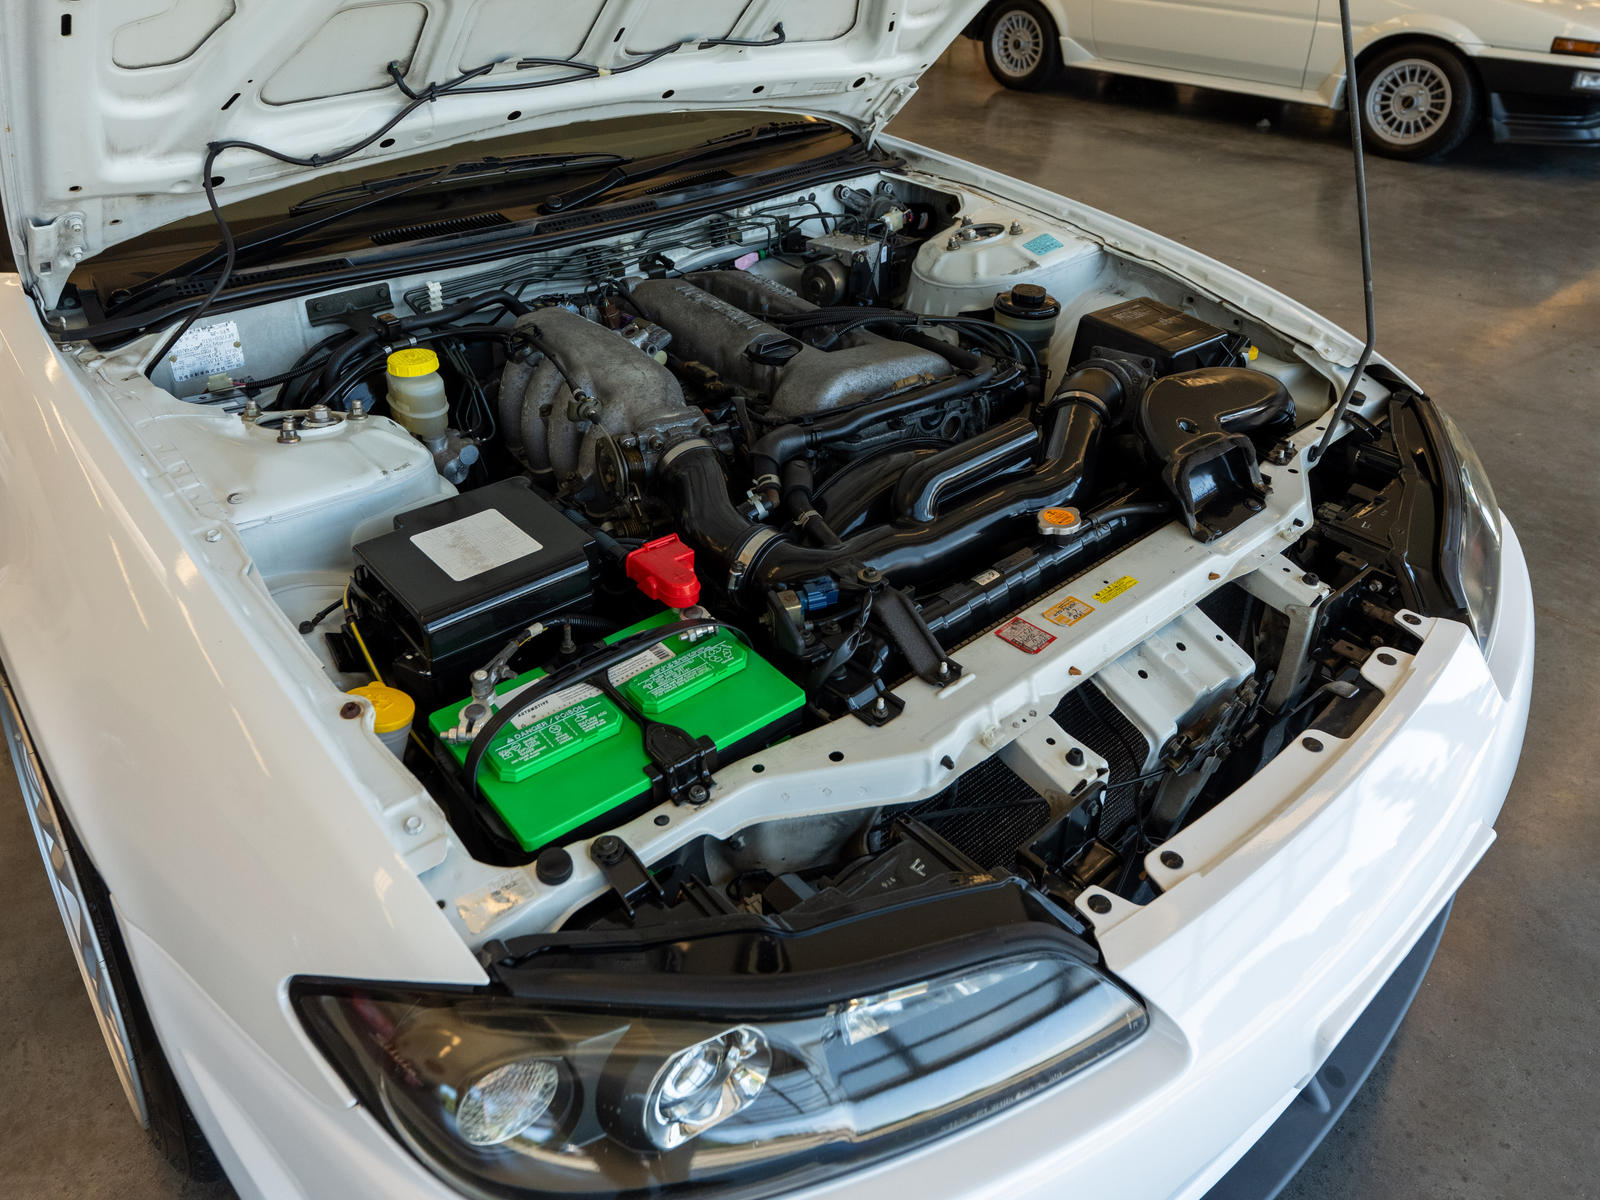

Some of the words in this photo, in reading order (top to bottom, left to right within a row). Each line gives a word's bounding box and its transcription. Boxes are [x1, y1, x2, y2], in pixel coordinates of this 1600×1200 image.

[518, 700, 549, 717] AUTOMOTIVE
[514, 721, 548, 740] DANGER
[554, 704, 585, 721] POISON
